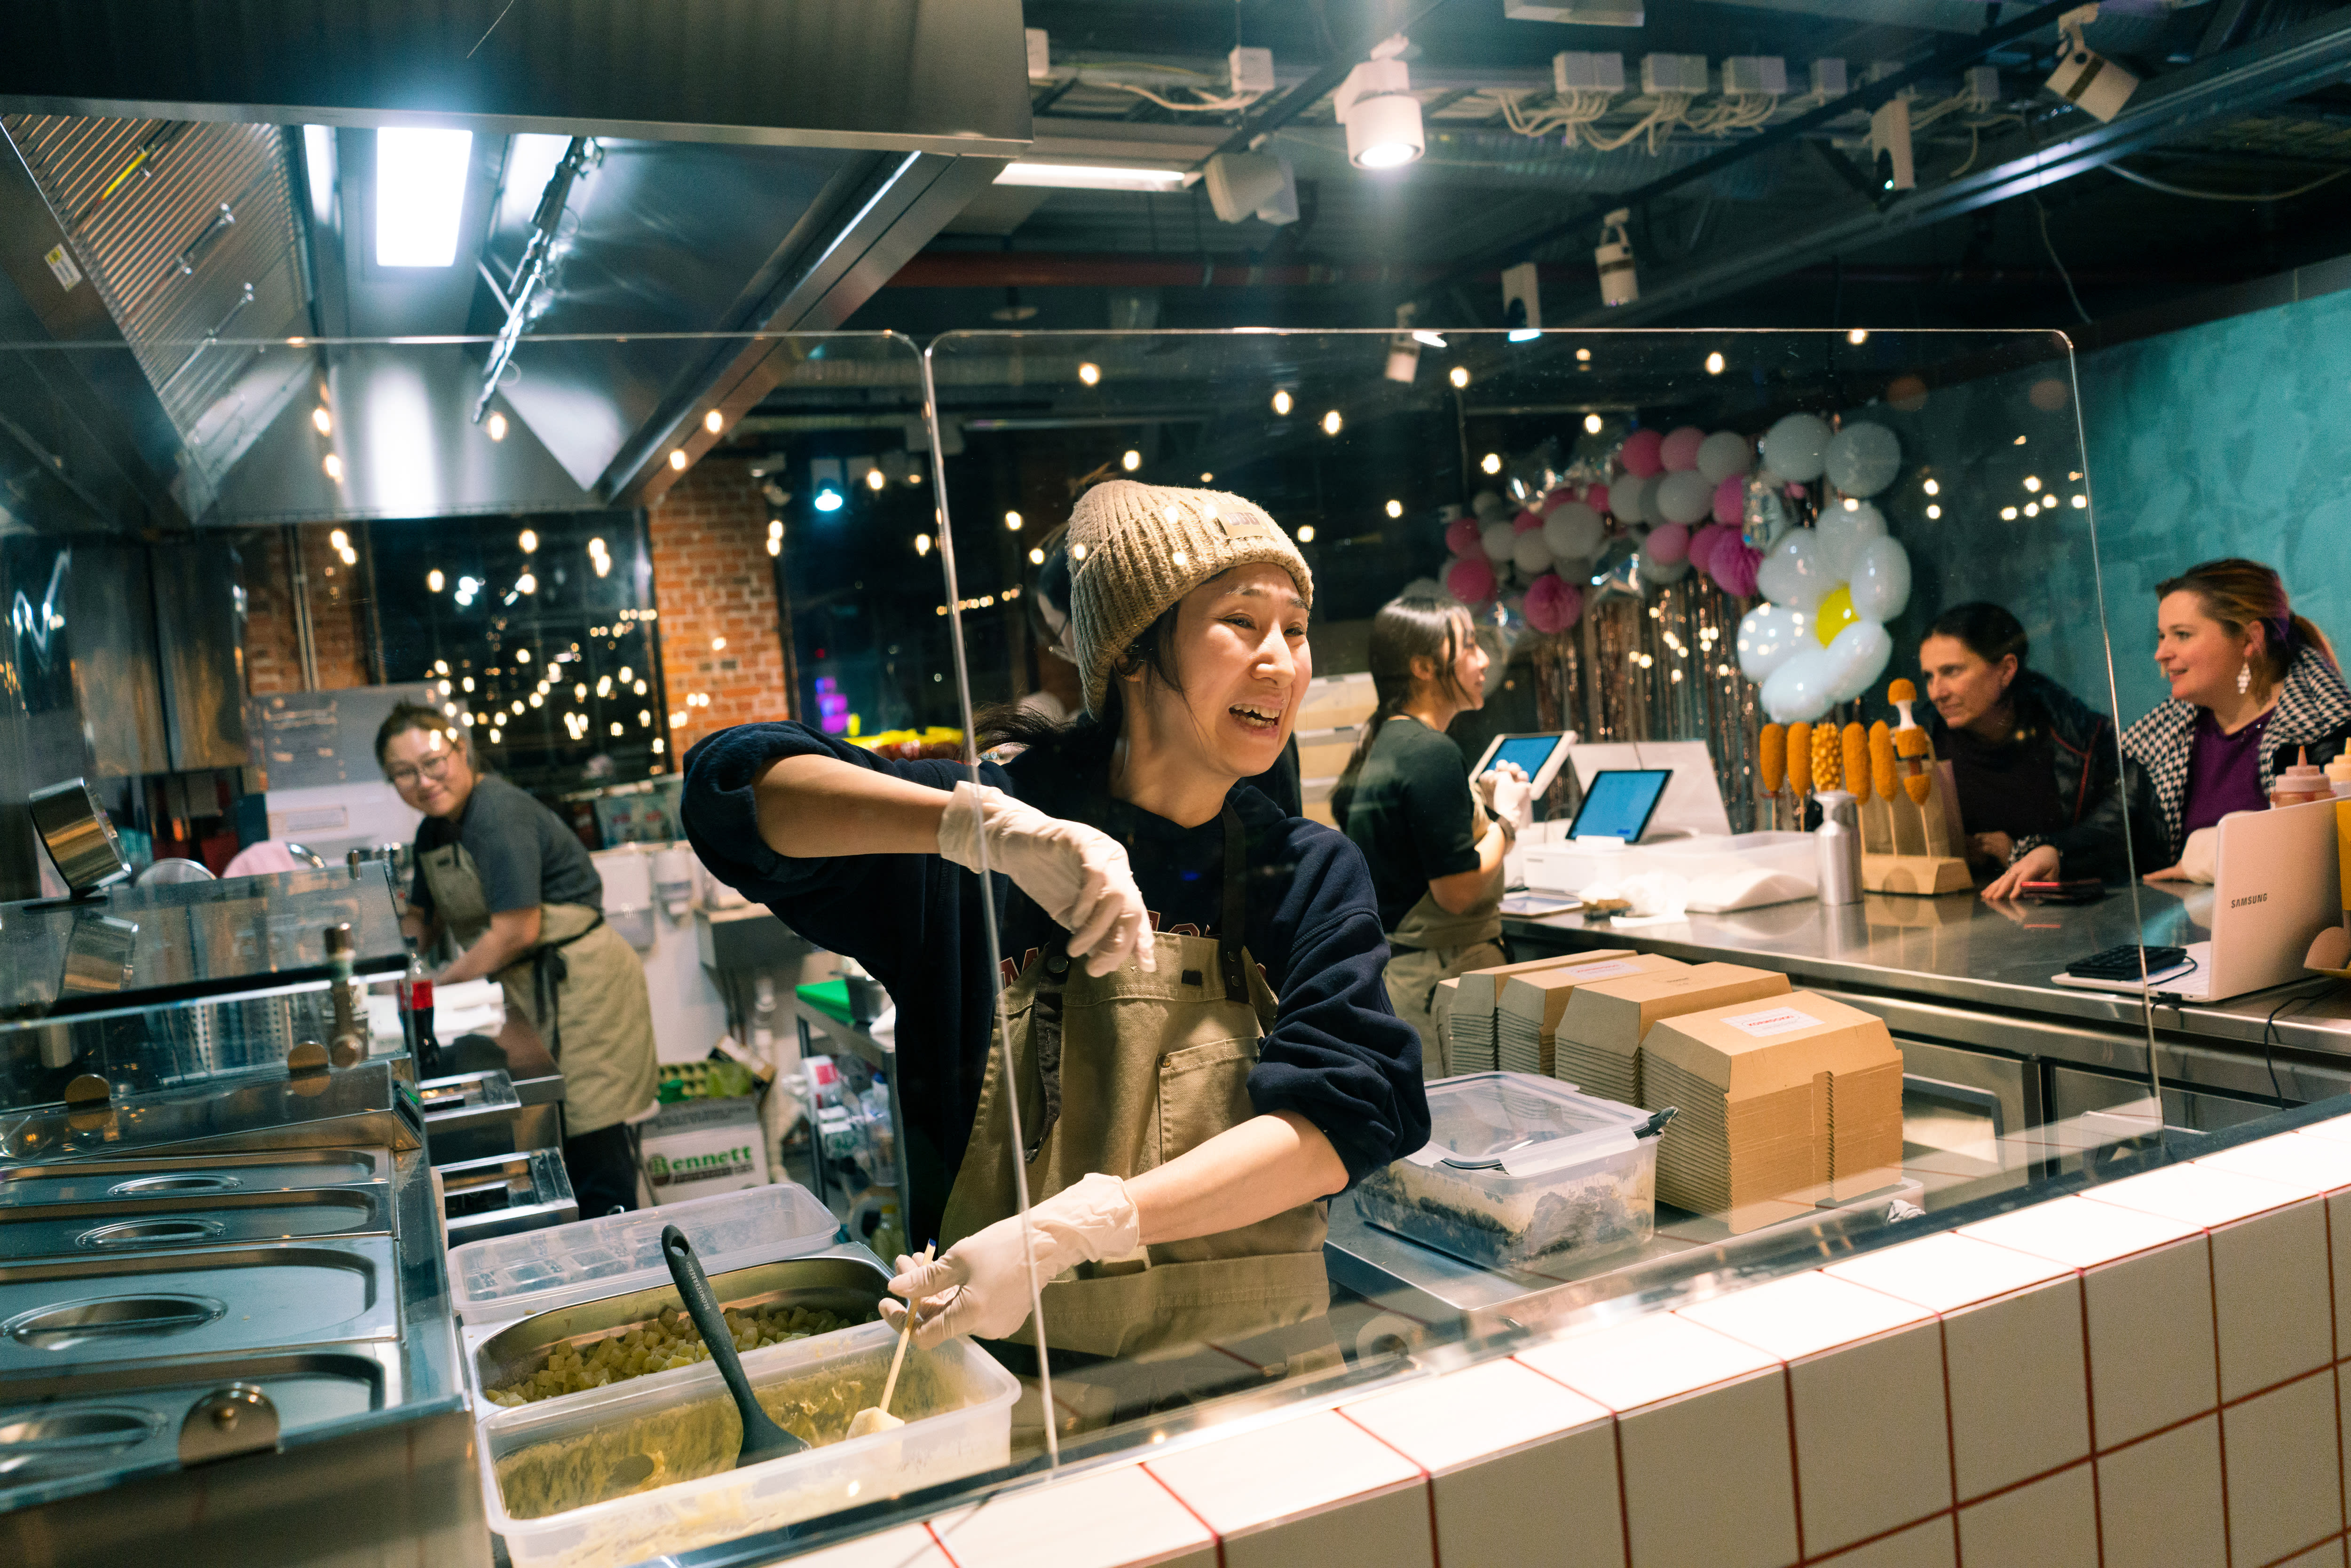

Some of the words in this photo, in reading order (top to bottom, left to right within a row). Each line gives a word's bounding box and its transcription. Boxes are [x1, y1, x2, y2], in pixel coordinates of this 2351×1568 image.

[2231, 893, 2267, 908] SAMSUNG
[652, 1145, 752, 1176] Bennett
[686, 1261, 710, 1310] BLOMSTERBERGS
